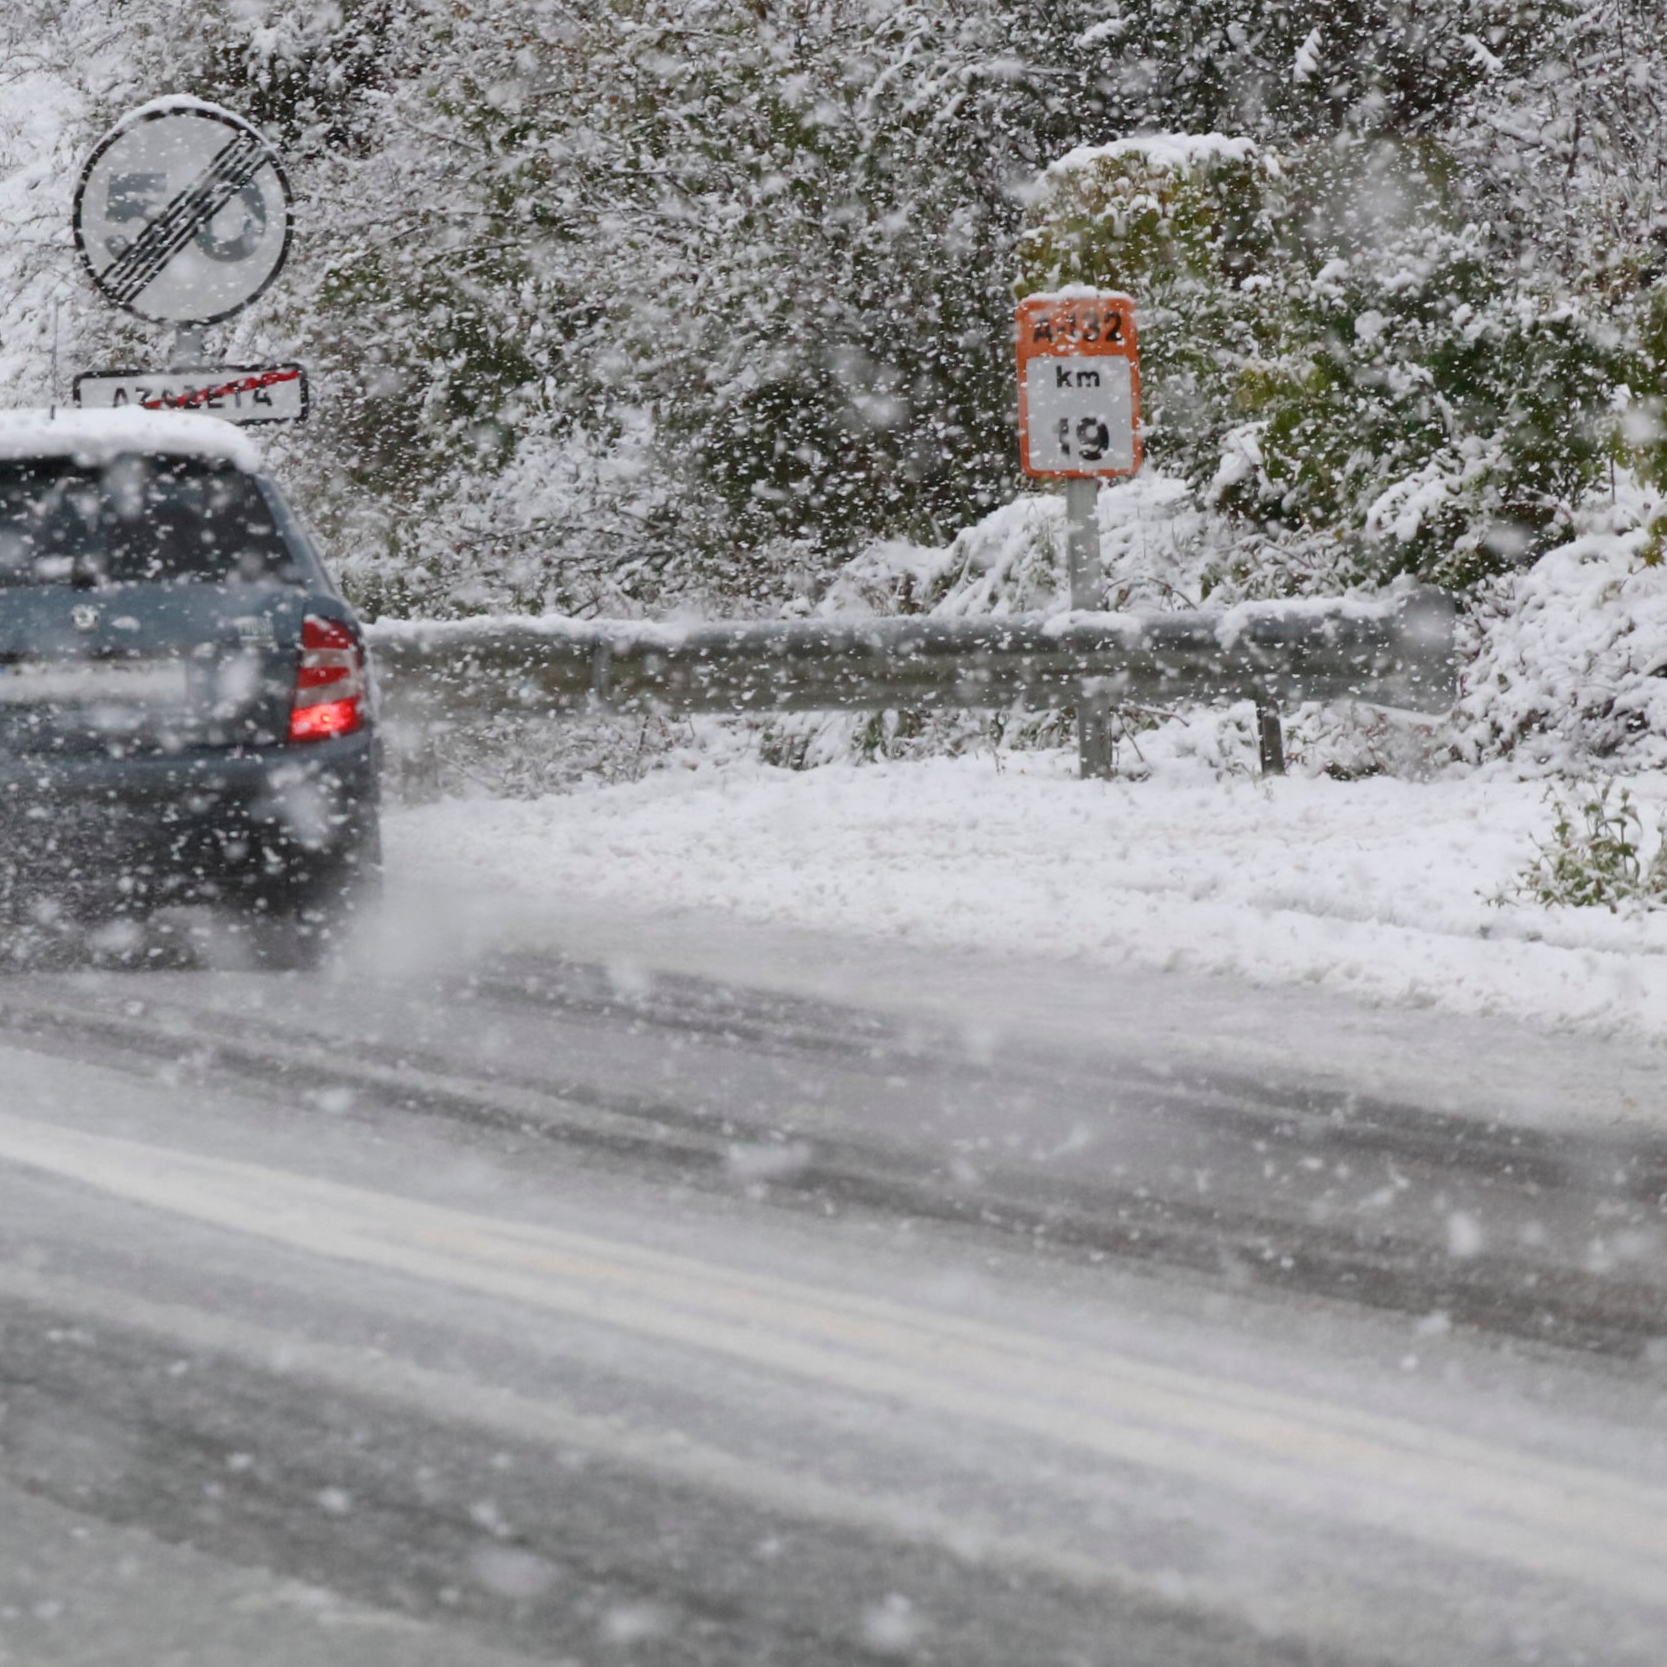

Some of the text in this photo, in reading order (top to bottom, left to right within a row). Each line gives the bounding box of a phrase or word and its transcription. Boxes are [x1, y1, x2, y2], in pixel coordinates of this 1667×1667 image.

[105, 172, 267, 266] 50
[1033, 310, 1124, 343] A-132
[1056, 365, 1101, 388] km
[1055, 416, 1110, 461] 19
